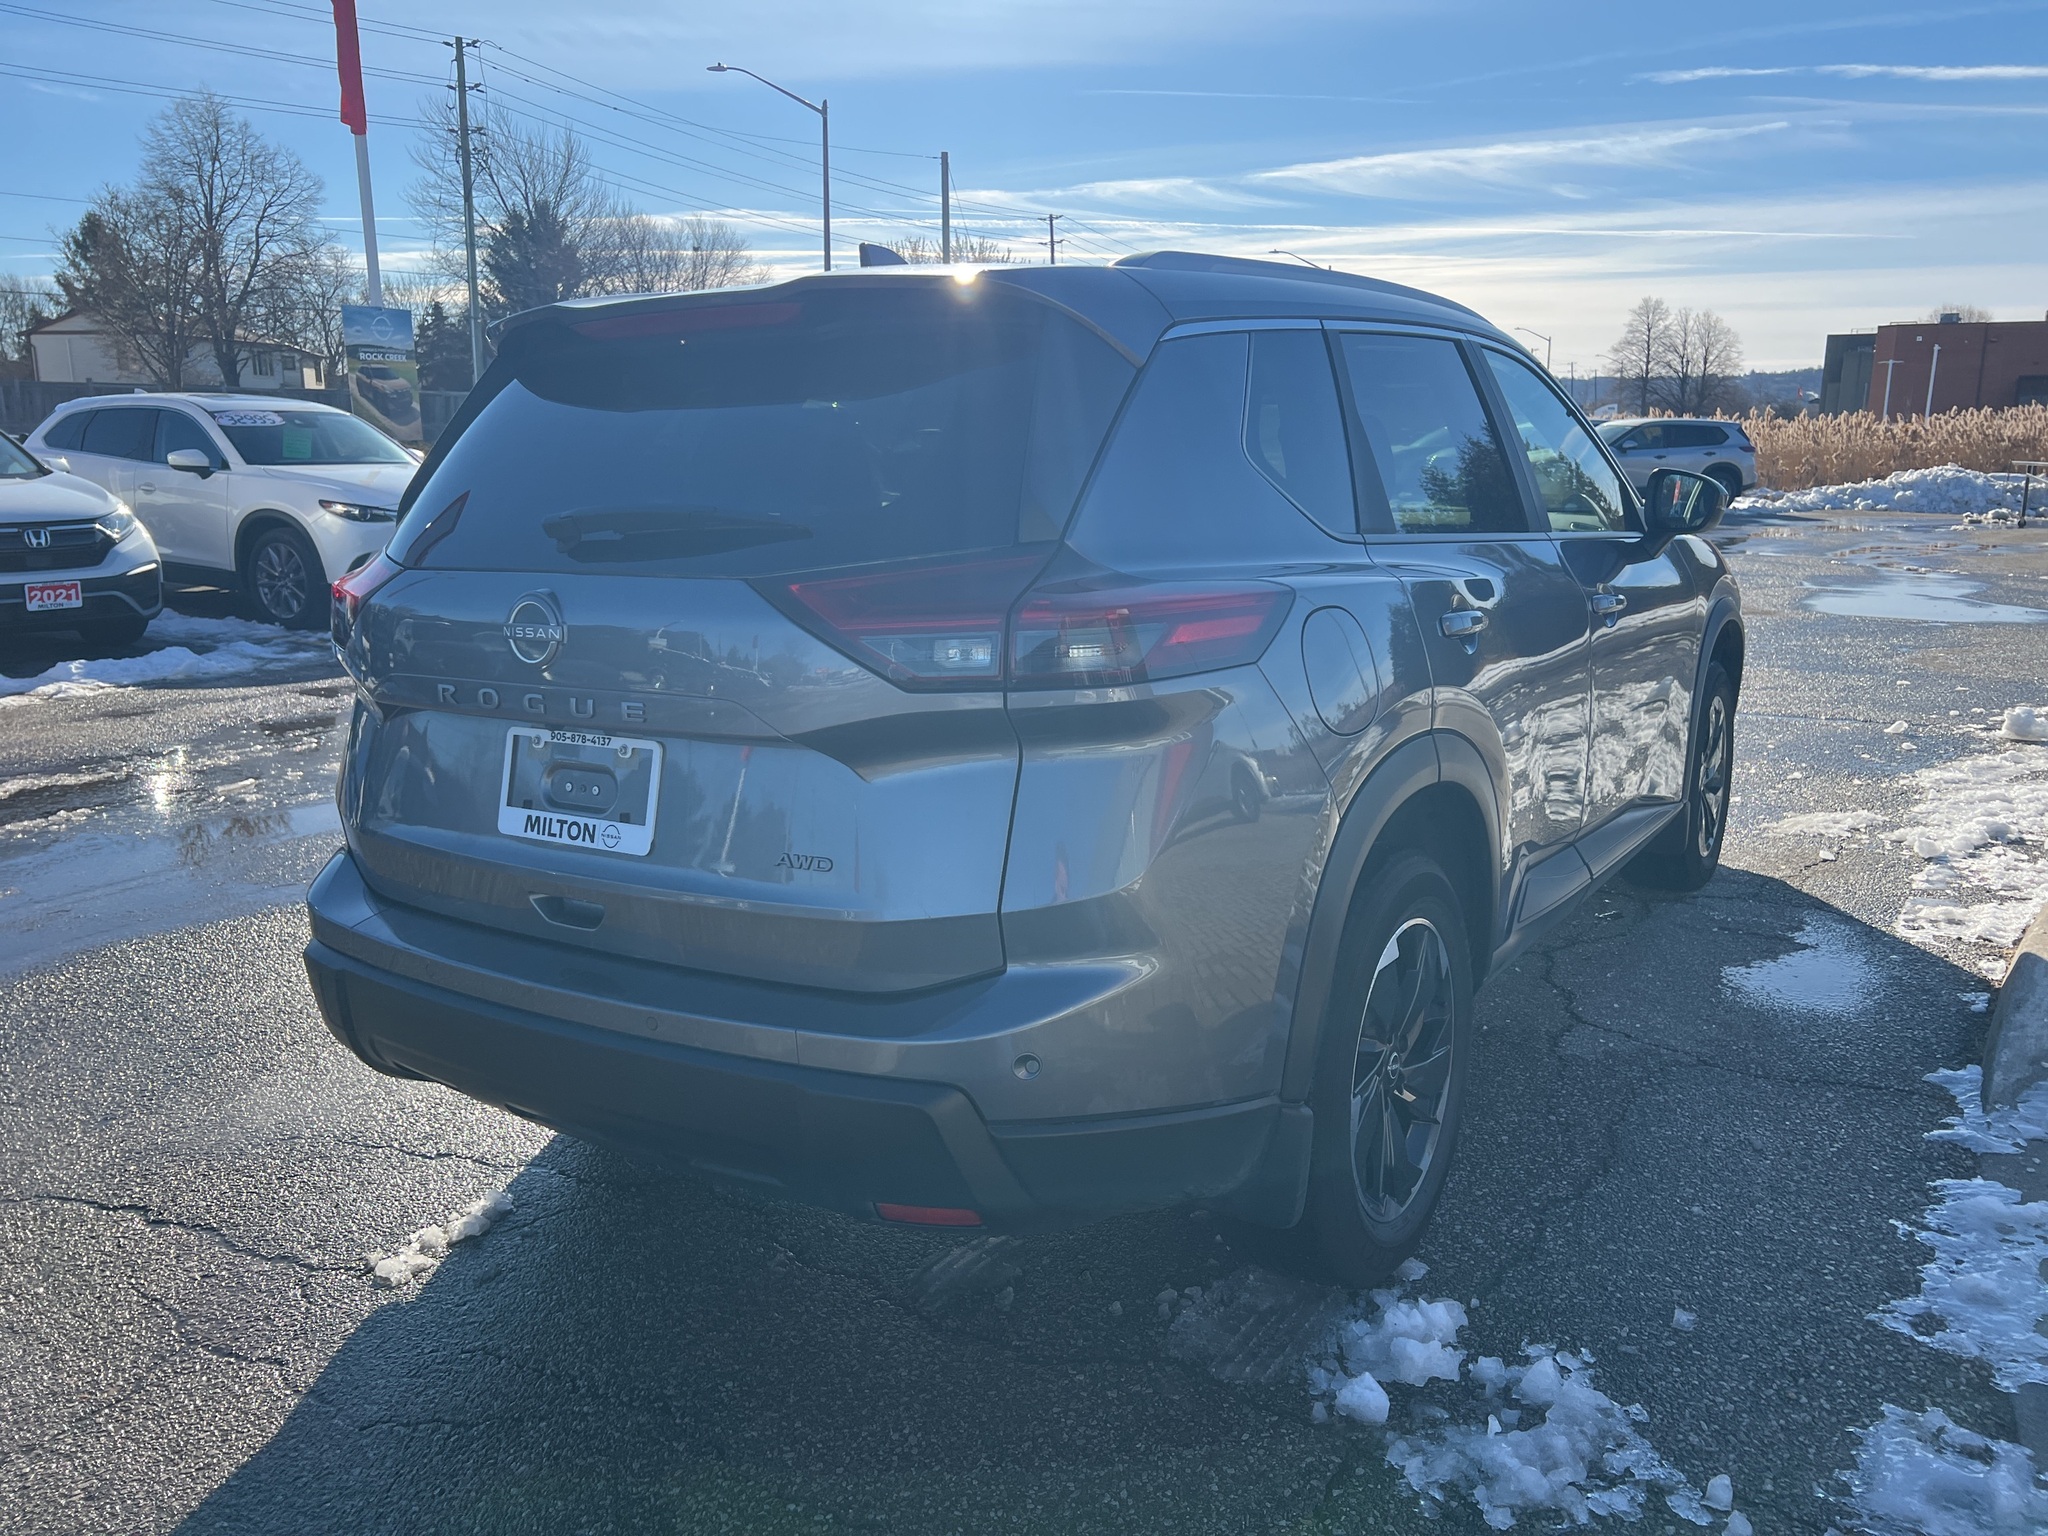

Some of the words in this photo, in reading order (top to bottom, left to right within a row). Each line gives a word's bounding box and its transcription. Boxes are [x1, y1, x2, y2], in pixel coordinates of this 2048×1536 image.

[359, 352, 384, 361] ROCK
[385, 353, 407, 362] CREEK
[30, 588, 77, 604] 2021
[503, 625, 561, 639] NISSAN
[437, 683, 648, 723] ROGUE
[550, 731, 612, 747] 905-878-4137
[524, 814, 597, 844] MILTON
[601, 832, 622, 841] NISSAN
[773, 852, 834, 873] AWD
